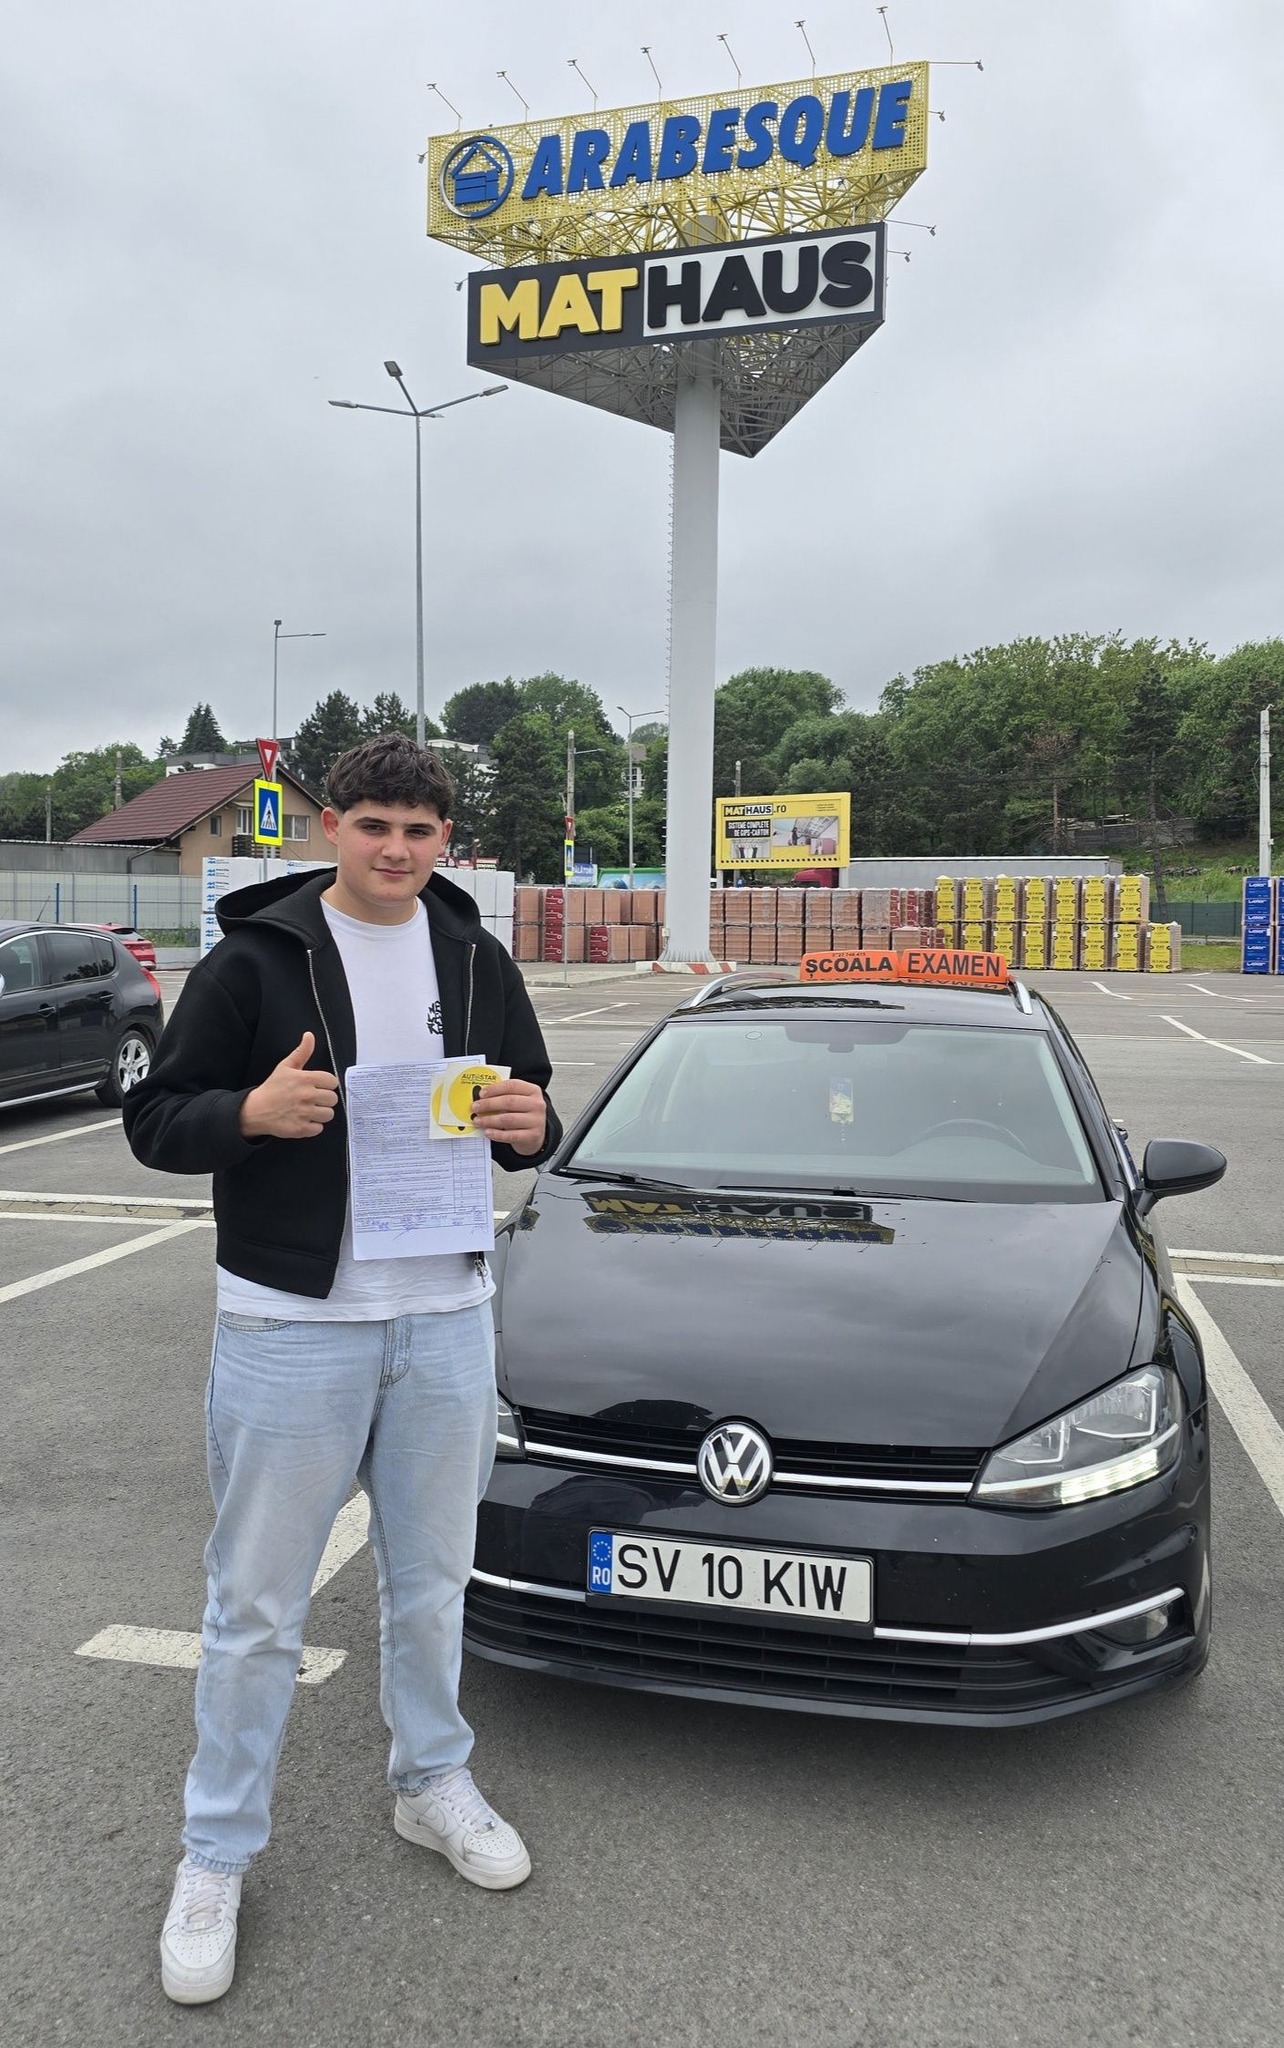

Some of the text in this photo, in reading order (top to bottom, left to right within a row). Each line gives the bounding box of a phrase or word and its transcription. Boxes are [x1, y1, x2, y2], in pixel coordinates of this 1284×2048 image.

[520, 80, 913, 199] ARABESQUE
[479, 240, 874, 345] MATHAUS
[908, 953, 1000, 977] EXAMEN
[592, 1566, 611, 1586] RO
[617, 1544, 847, 1612] SV 10 KIW
